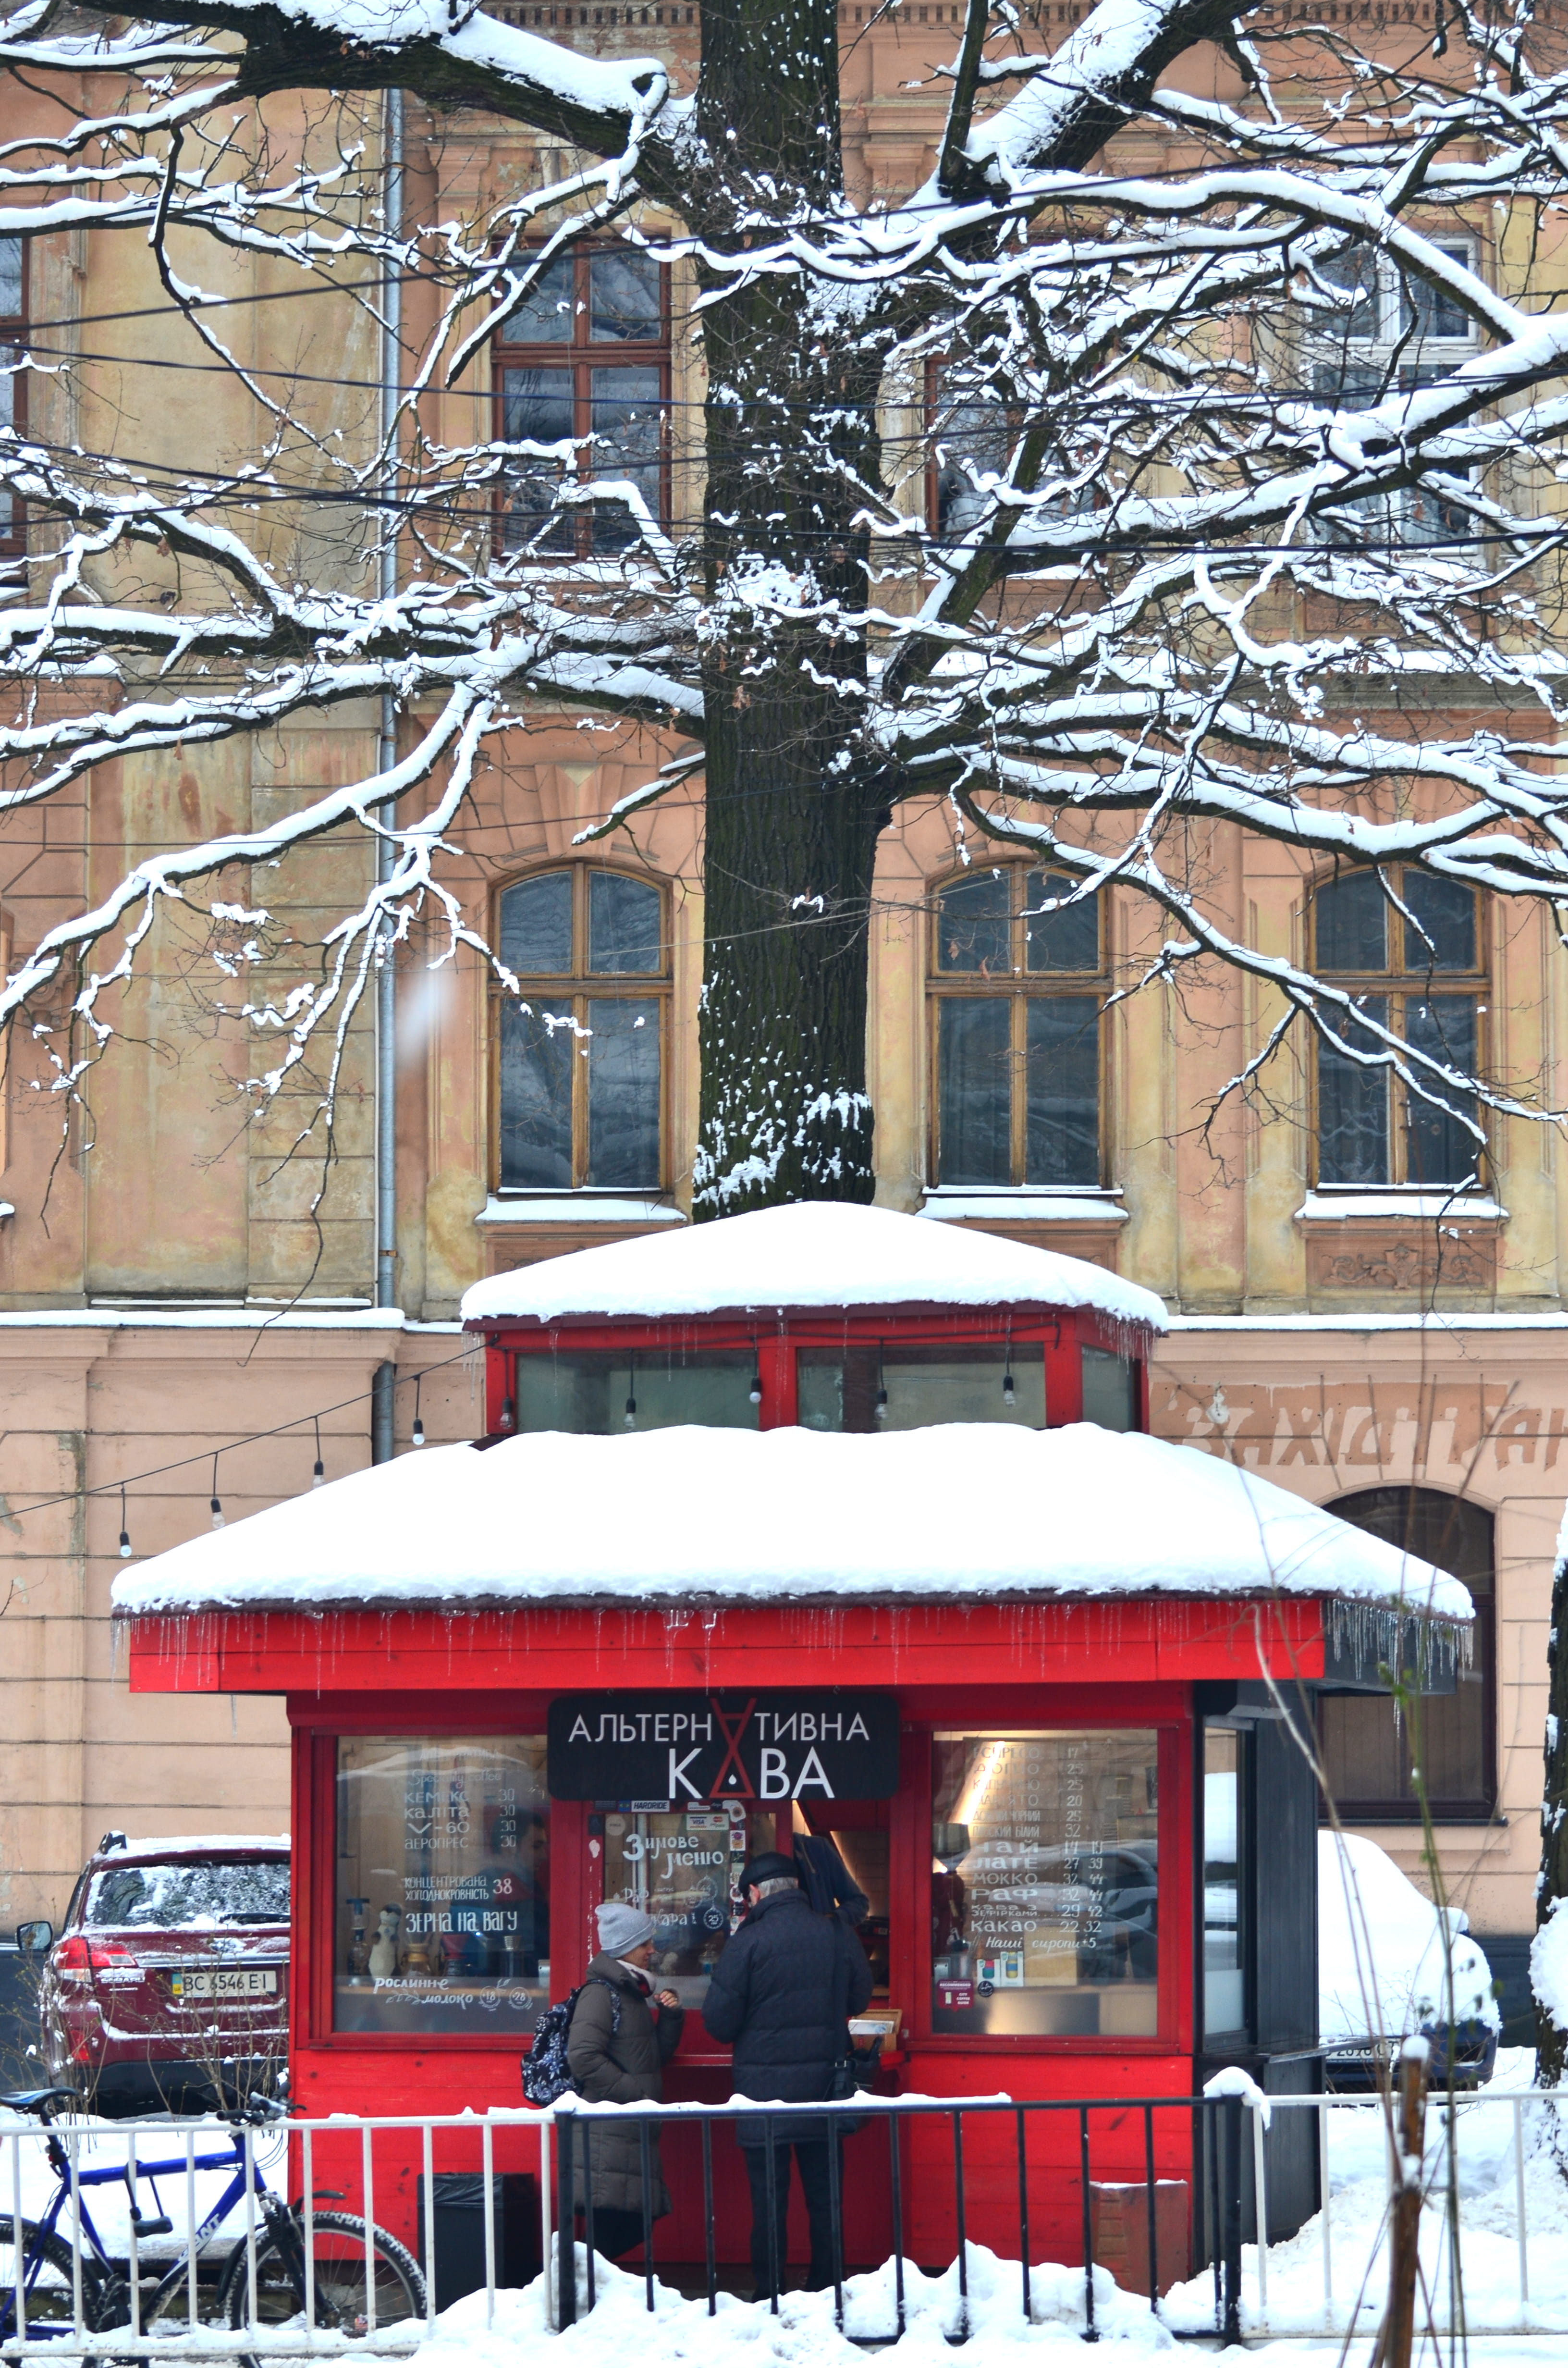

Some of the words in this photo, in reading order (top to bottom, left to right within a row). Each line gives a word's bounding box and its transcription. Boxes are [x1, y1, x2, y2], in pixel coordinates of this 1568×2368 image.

[1067, 1747, 1079, 1759] 17
[669, 1746, 835, 1799] КАВА
[1066, 1763, 1083, 1775] 25
[1066, 1779, 1083, 1791] 25
[499, 1788, 514, 1801] 30
[1066, 1795, 1082, 1807] 20
[499, 1804, 515, 1816] 30
[1066, 1810, 1081, 1822] 25
[500, 1820, 516, 1832] 30
[1065, 1823, 1080, 1838] 32
[501, 1835, 516, 1848] 30
[622, 1833, 699, 1860] Зимове
[1065, 1841, 1078, 1854] 14
[1064, 1857, 1080, 1869] 27
[1088, 1857, 1103, 1869] 39
[972, 1873, 1038, 1885] МОККО
[1063, 1874, 1078, 1885] 32
[1089, 1874, 1103, 1885] 44
[492, 1878, 513, 1894] 38
[1063, 1888, 1080, 1901] 32
[1089, 1889, 1103, 1901] 44
[1061, 1904, 1080, 1917] 29
[1088, 1905, 1102, 1917] 42
[1060, 1921, 1080, 1933] 22
[1084, 1921, 1102, 1933] 32
[986, 1936, 1023, 1948] Наші
